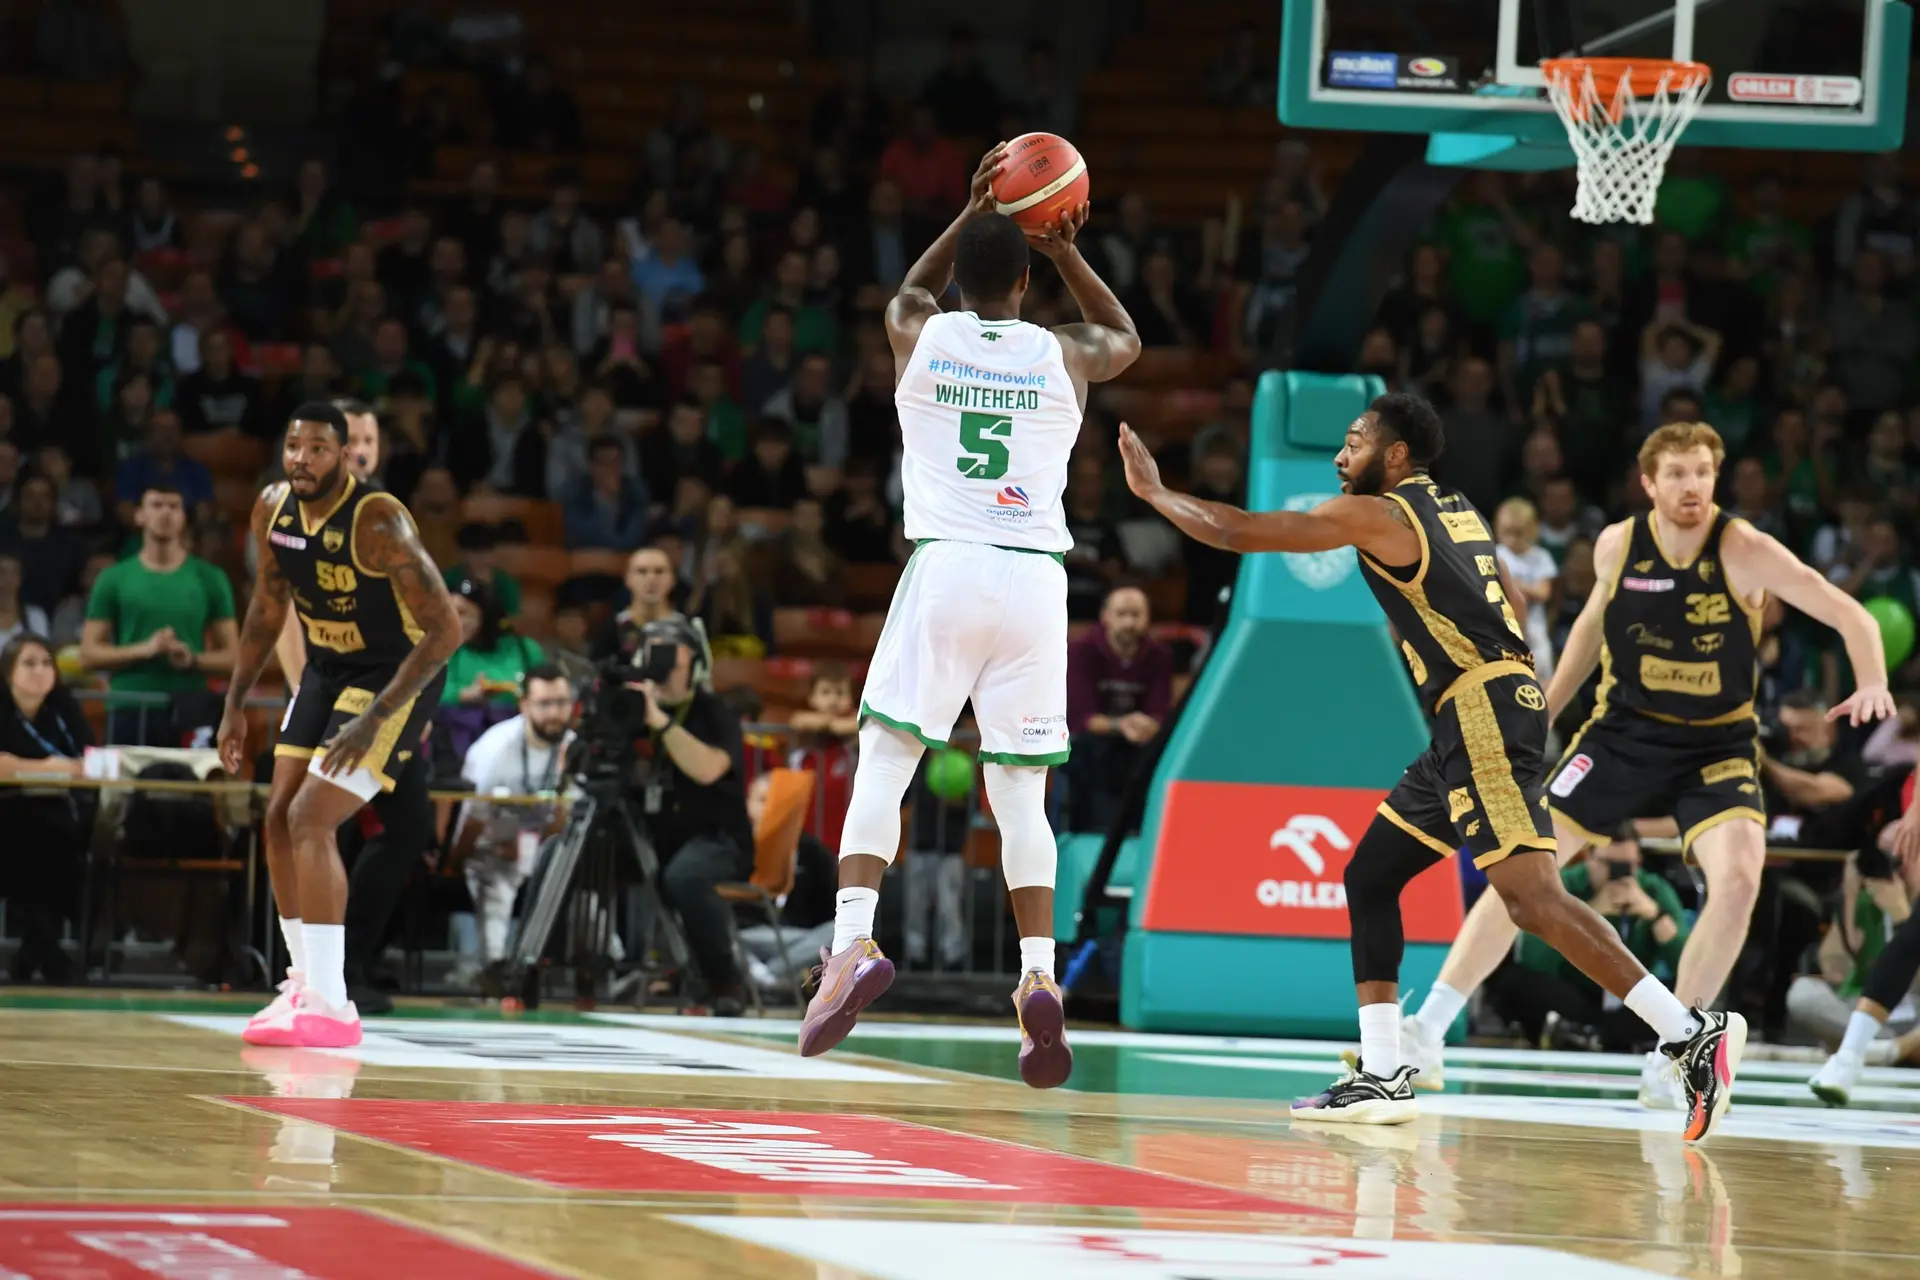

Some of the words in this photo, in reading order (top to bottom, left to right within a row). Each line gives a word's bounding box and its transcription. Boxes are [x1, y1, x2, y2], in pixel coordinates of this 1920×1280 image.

[928, 358, 1047, 388] #PijKranówkę
[935, 383, 1039, 411] WHITEHEAD
[956, 411, 1013, 480] 5
[315, 559, 358, 593] 50
[1685, 592, 1733, 625] 32
